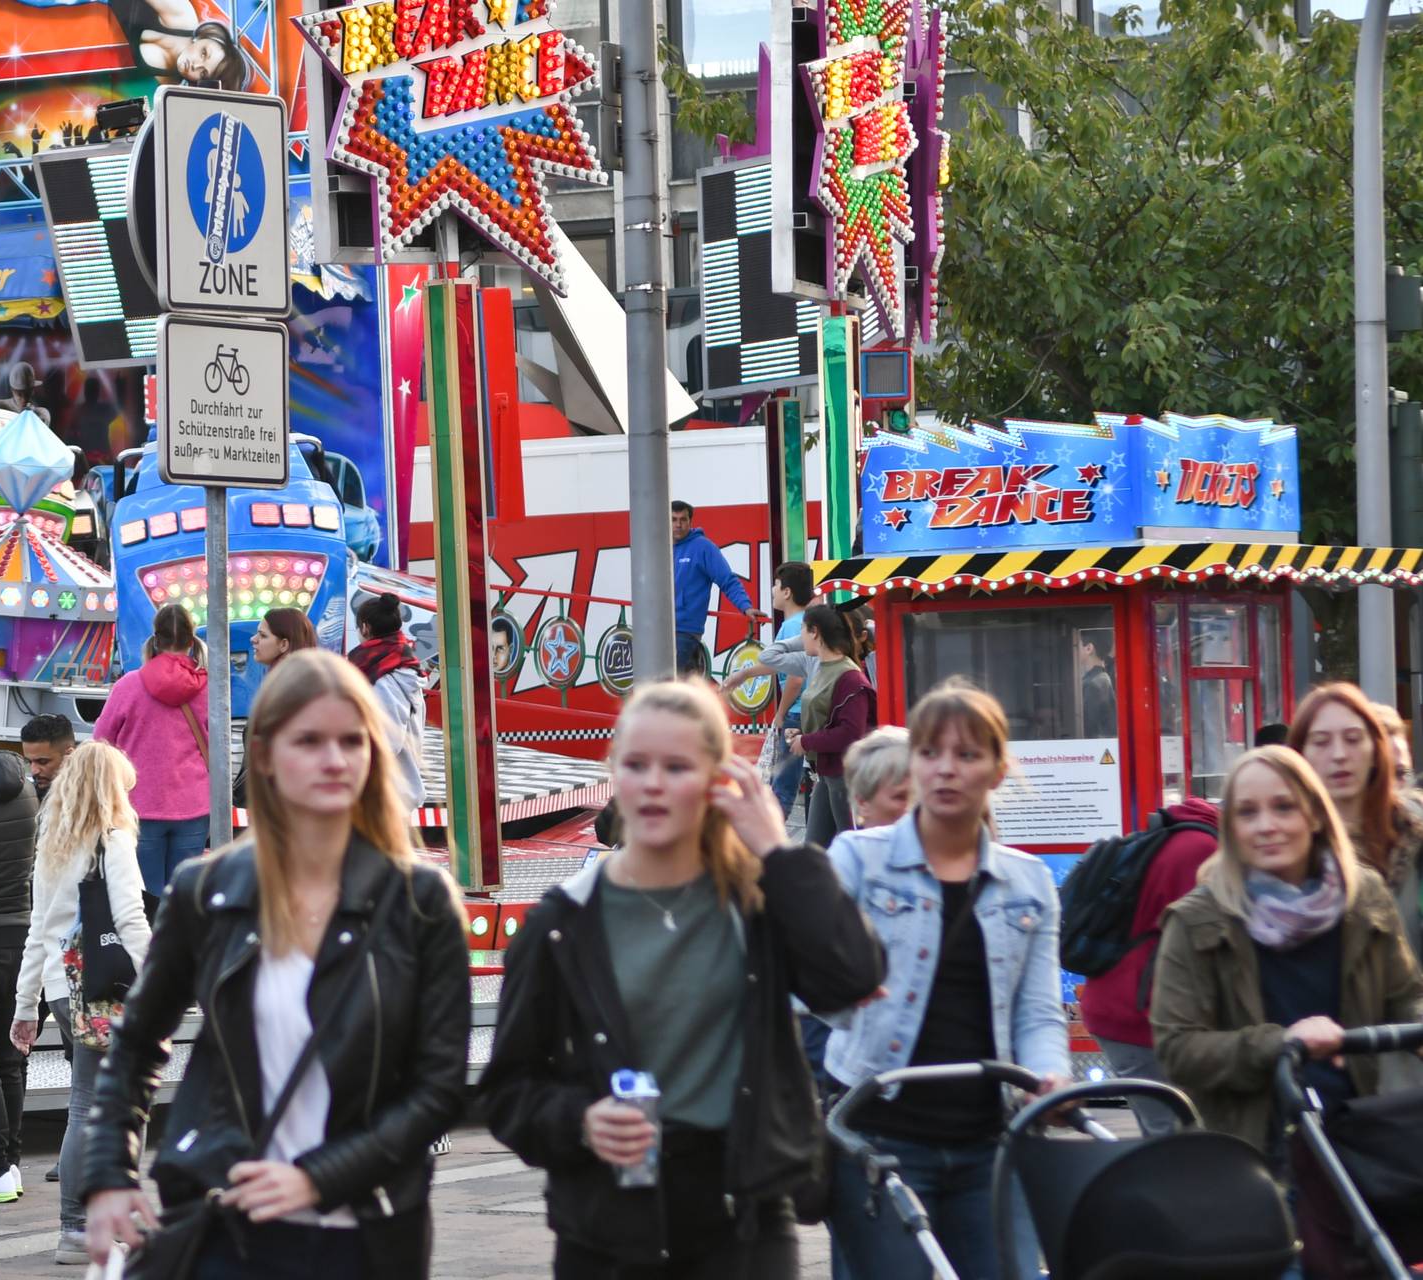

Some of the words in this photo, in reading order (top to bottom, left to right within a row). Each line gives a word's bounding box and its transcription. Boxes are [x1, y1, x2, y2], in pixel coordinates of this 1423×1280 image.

[338, 0, 487, 75] BREAK
[412, 30, 565, 118] DANCE
[199, 261, 258, 296] ZONE
[190, 399, 244, 418] Durchfahrt
[248, 407, 263, 420] zur
[178, 419, 256, 441] Schützenstraße
[260, 427, 277, 443] frei
[223, 445, 281, 464] Marktzeiten
[881, 464, 1059, 502] BREAK
[1175, 457, 1260, 508] TICKETS
[928, 488, 1091, 529] DANCE
[1018, 753, 1095, 765] cherheitshinweise
